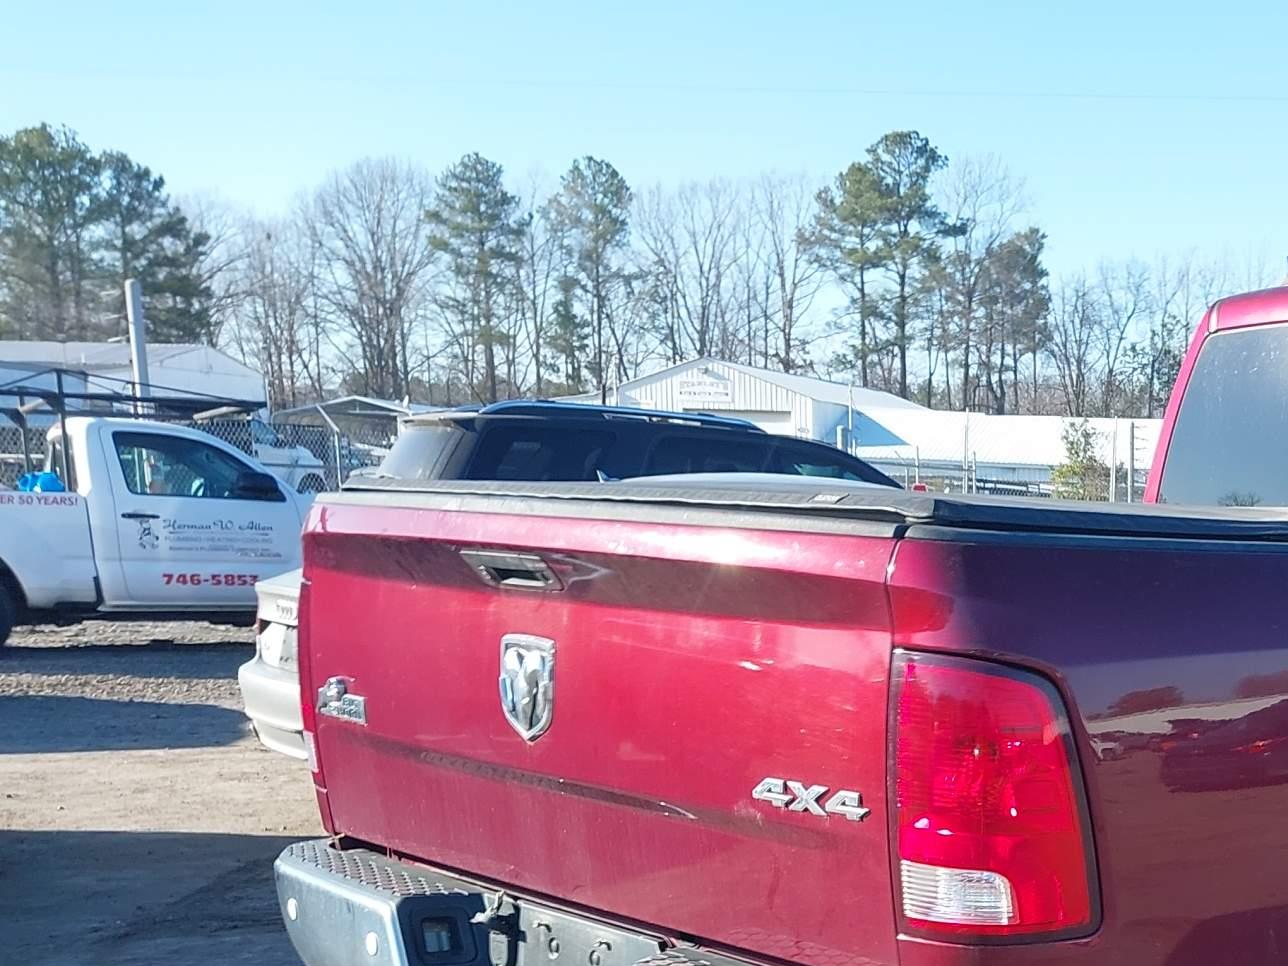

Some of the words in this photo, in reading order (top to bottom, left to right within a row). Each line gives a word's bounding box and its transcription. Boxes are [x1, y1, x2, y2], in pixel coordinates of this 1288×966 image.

[20, 495, 34, 505] 50
[37, 496, 79, 506] YEARS!
[162, 573, 259, 587] 746-5853
